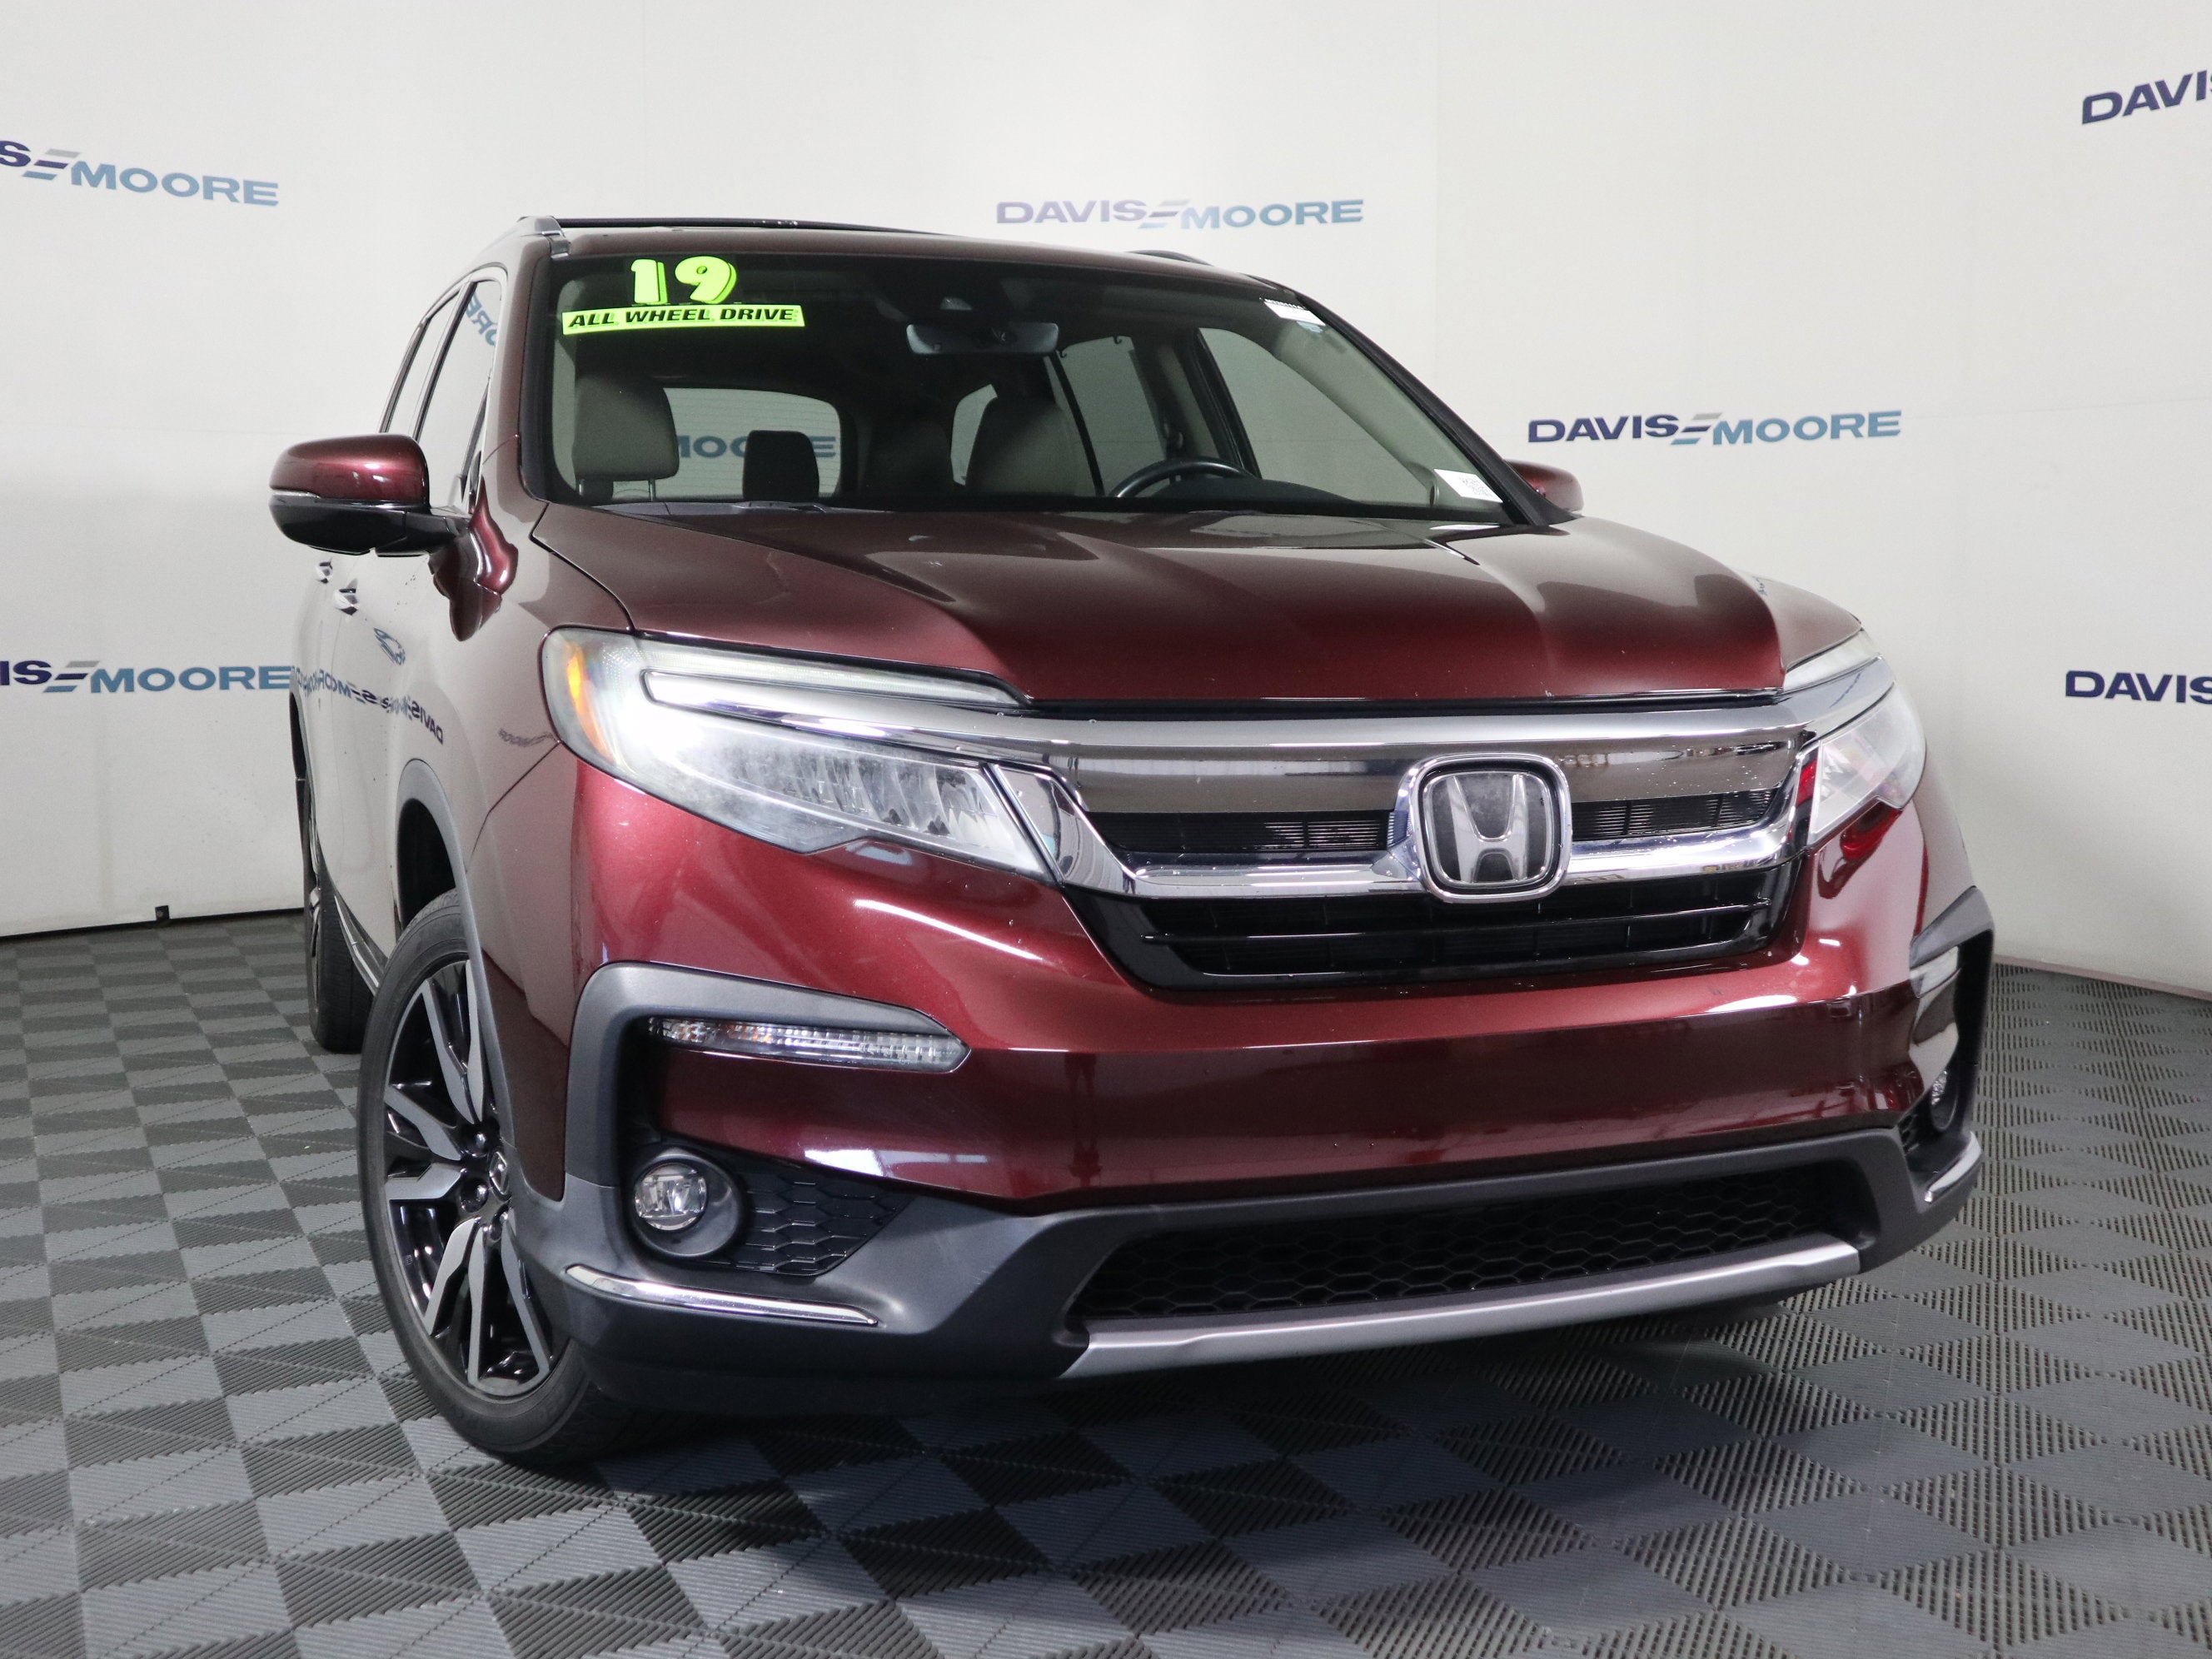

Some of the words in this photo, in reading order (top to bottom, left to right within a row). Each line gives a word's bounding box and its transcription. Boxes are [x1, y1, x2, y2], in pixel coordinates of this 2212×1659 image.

[2081, 70, 2212, 125] DAVI
[71, 161, 278, 207] MOORE
[996, 199, 1147, 224] DAVIS
[1180, 199, 1364, 229] MOORE
[630, 256, 737, 304] 19
[568, 312, 616, 328] ALL
[625, 308, 710, 324] WHEEL
[720, 308, 795, 321] DRIVE
[1528, 414, 1679, 443] DAVIS
[1712, 410, 1901, 445] MOORE
[91, 666, 292, 694] MOORE
[2065, 670, 2212, 705] DAVIS
